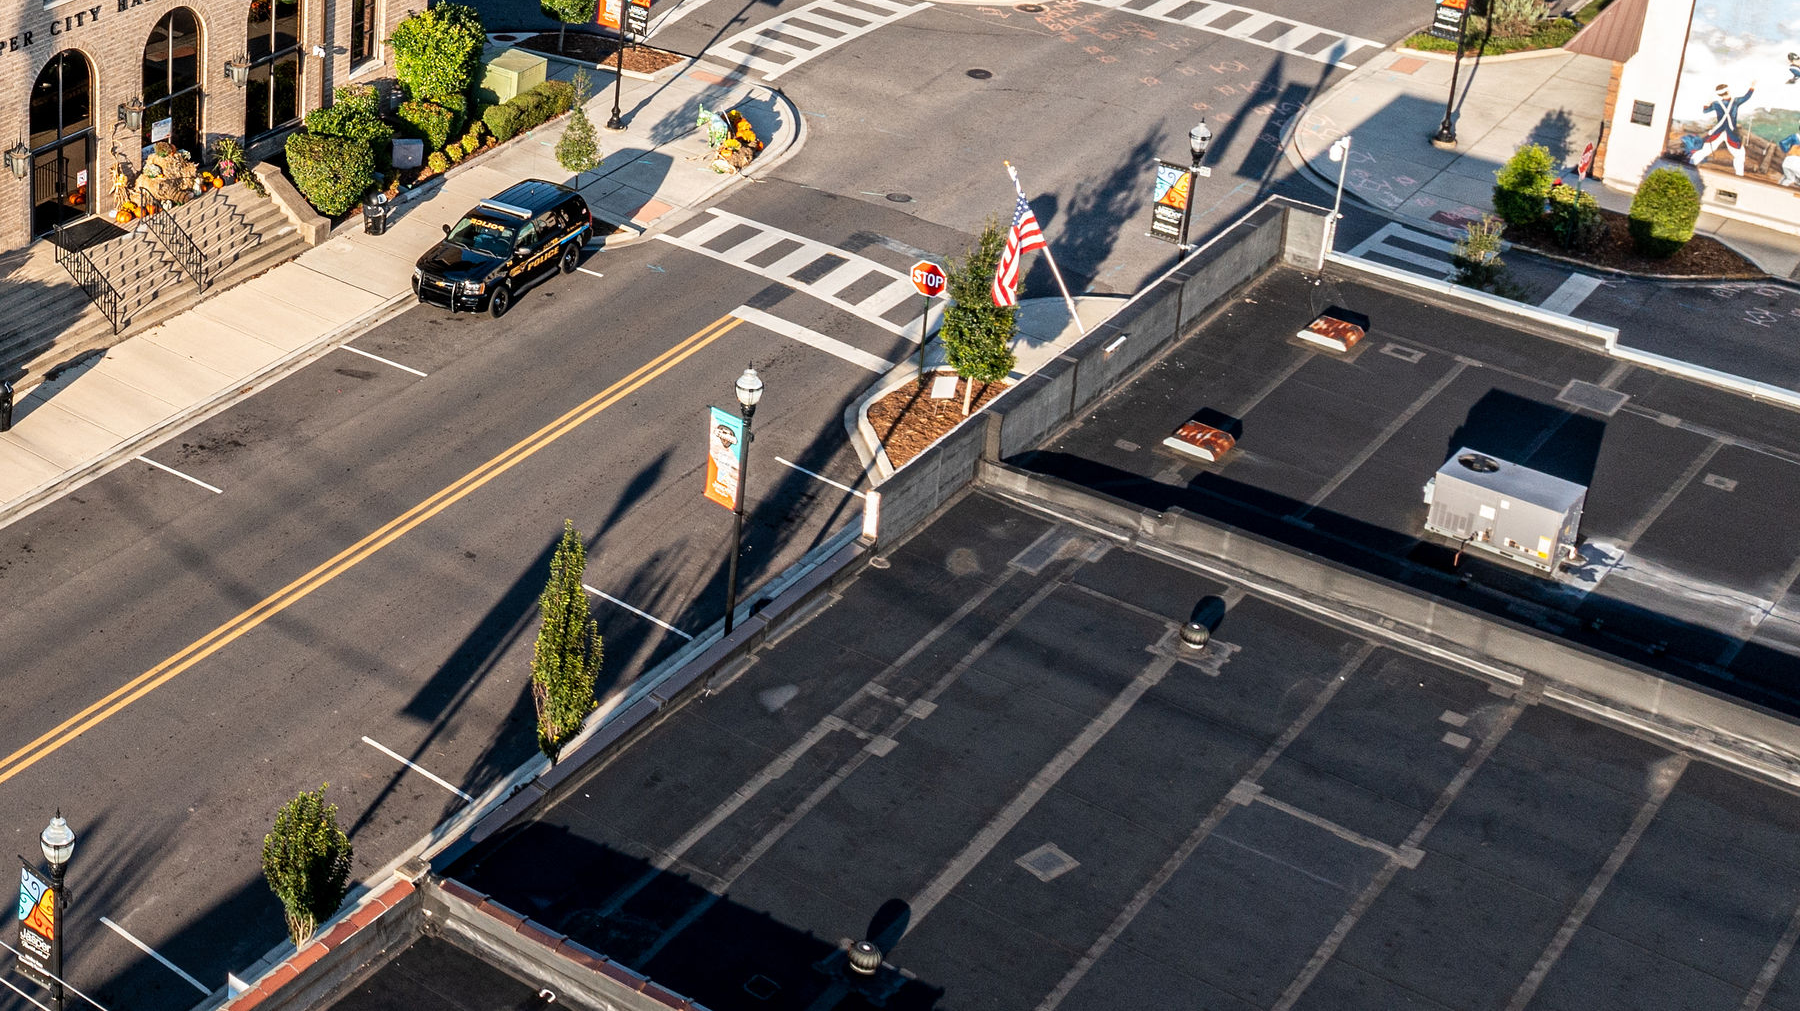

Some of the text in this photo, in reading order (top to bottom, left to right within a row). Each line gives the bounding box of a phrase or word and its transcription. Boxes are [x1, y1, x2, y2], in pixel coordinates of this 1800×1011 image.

[50, 5, 102, 37] CITY
[527, 246, 560, 271] POLICE
[913, 269, 944, 288] STOP
[20, 928, 52, 953] Jasper
